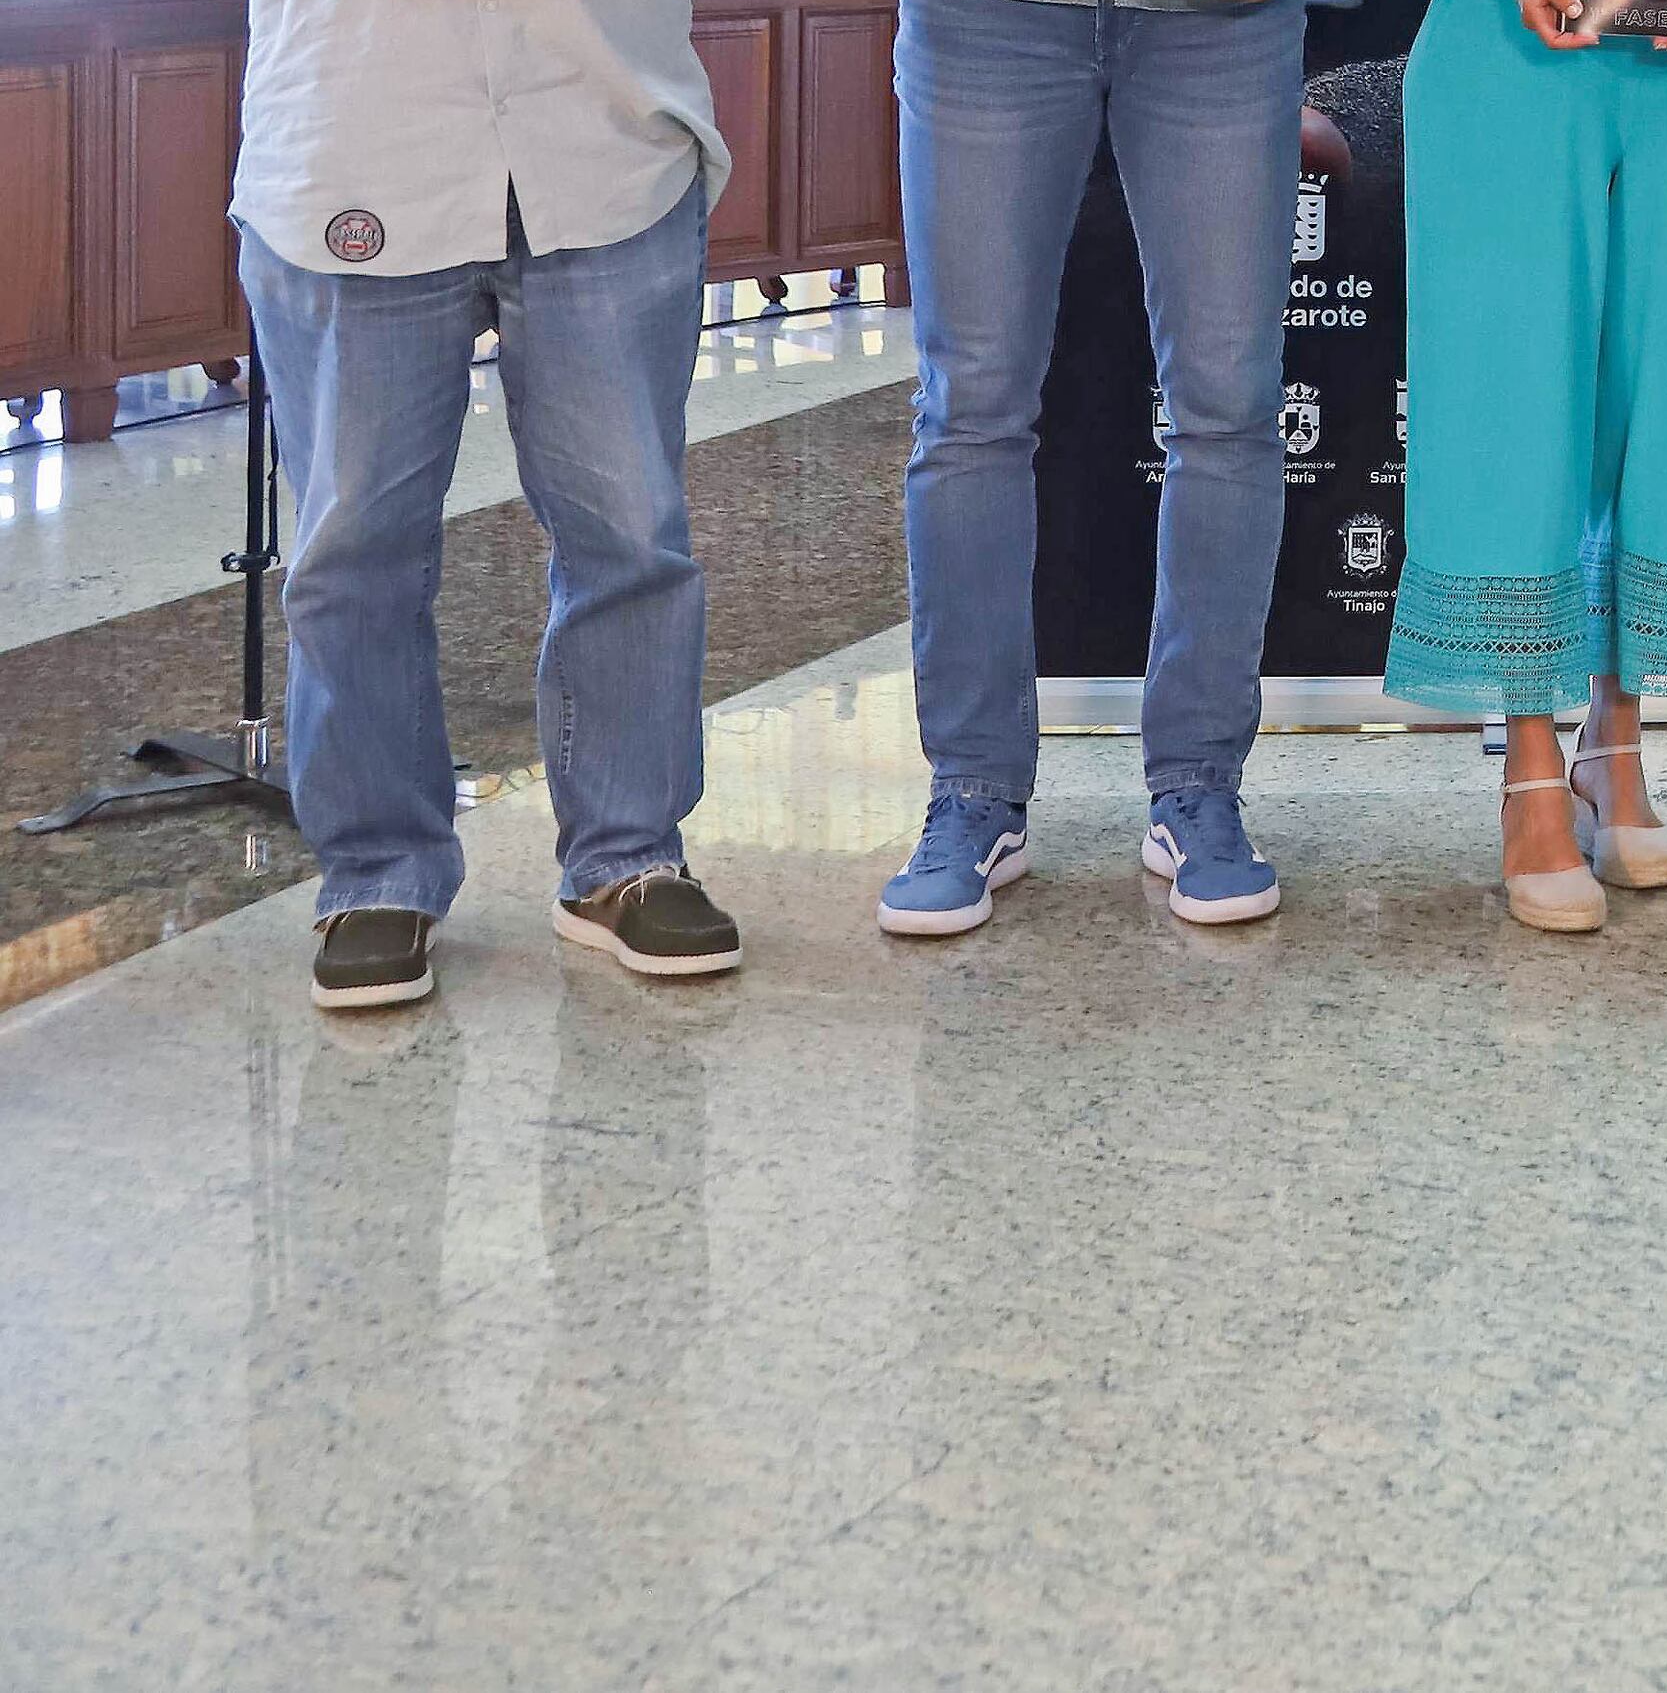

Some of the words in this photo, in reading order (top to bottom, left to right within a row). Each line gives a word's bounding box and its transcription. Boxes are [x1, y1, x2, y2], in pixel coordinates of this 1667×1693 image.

[1336, 275, 1373, 298] de
[1281, 305, 1367, 327] zarote
[1324, 460, 1336, 469] de
[1370, 471, 1397, 484] San
[1327, 589, 1389, 599] Ayuntamiento
[1343, 600, 1386, 613] Tinajo
